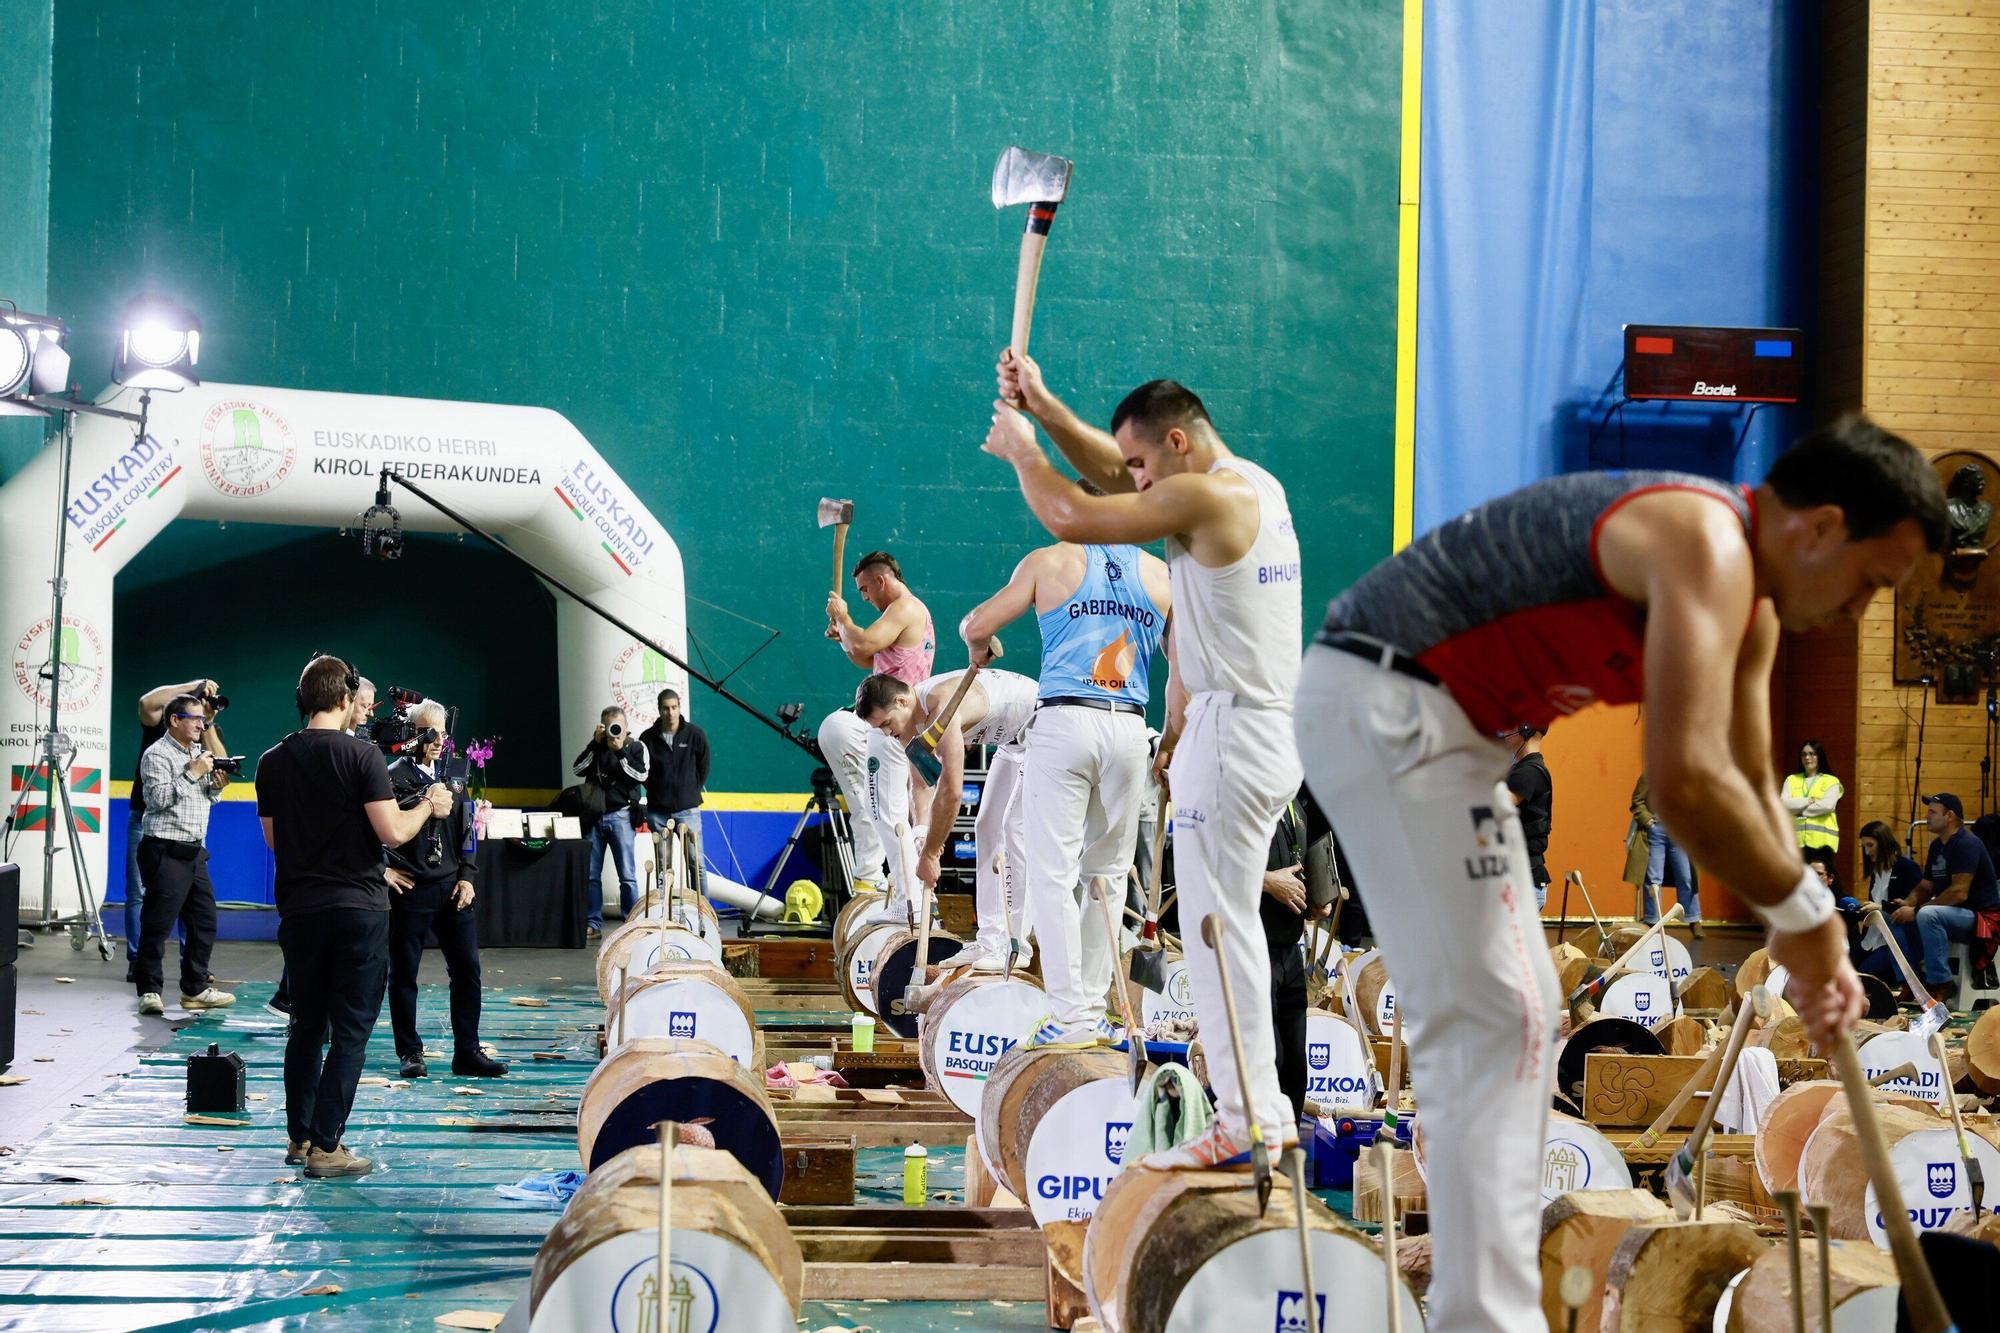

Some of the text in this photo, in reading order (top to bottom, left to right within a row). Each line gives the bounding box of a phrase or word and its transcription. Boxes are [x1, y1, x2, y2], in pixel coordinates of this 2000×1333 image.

[1692, 382, 1737, 396] Bodet
[314, 430, 497, 456] EUSKADIKO HERRI
[65, 433, 163, 529] EUSKADI
[313, 457, 542, 485] KIROL FEDERAKUNDEA
[83, 452, 174, 544] BASQUE COUNTRY
[572, 459, 655, 557] EUSKADI
[560, 475, 643, 567] BASQUE COUNTRY
[1069, 599, 1155, 628] GABIRONDO
[1082, 678, 1107, 689] IPAR
[1109, 679, 1128, 689] OIL
[400, 739, 419, 752] RONIN
[963, 833, 971, 841] 6
[1334, 1096, 1350, 1104] Bizi.
[1037, 1174, 1113, 1201] GIPU
